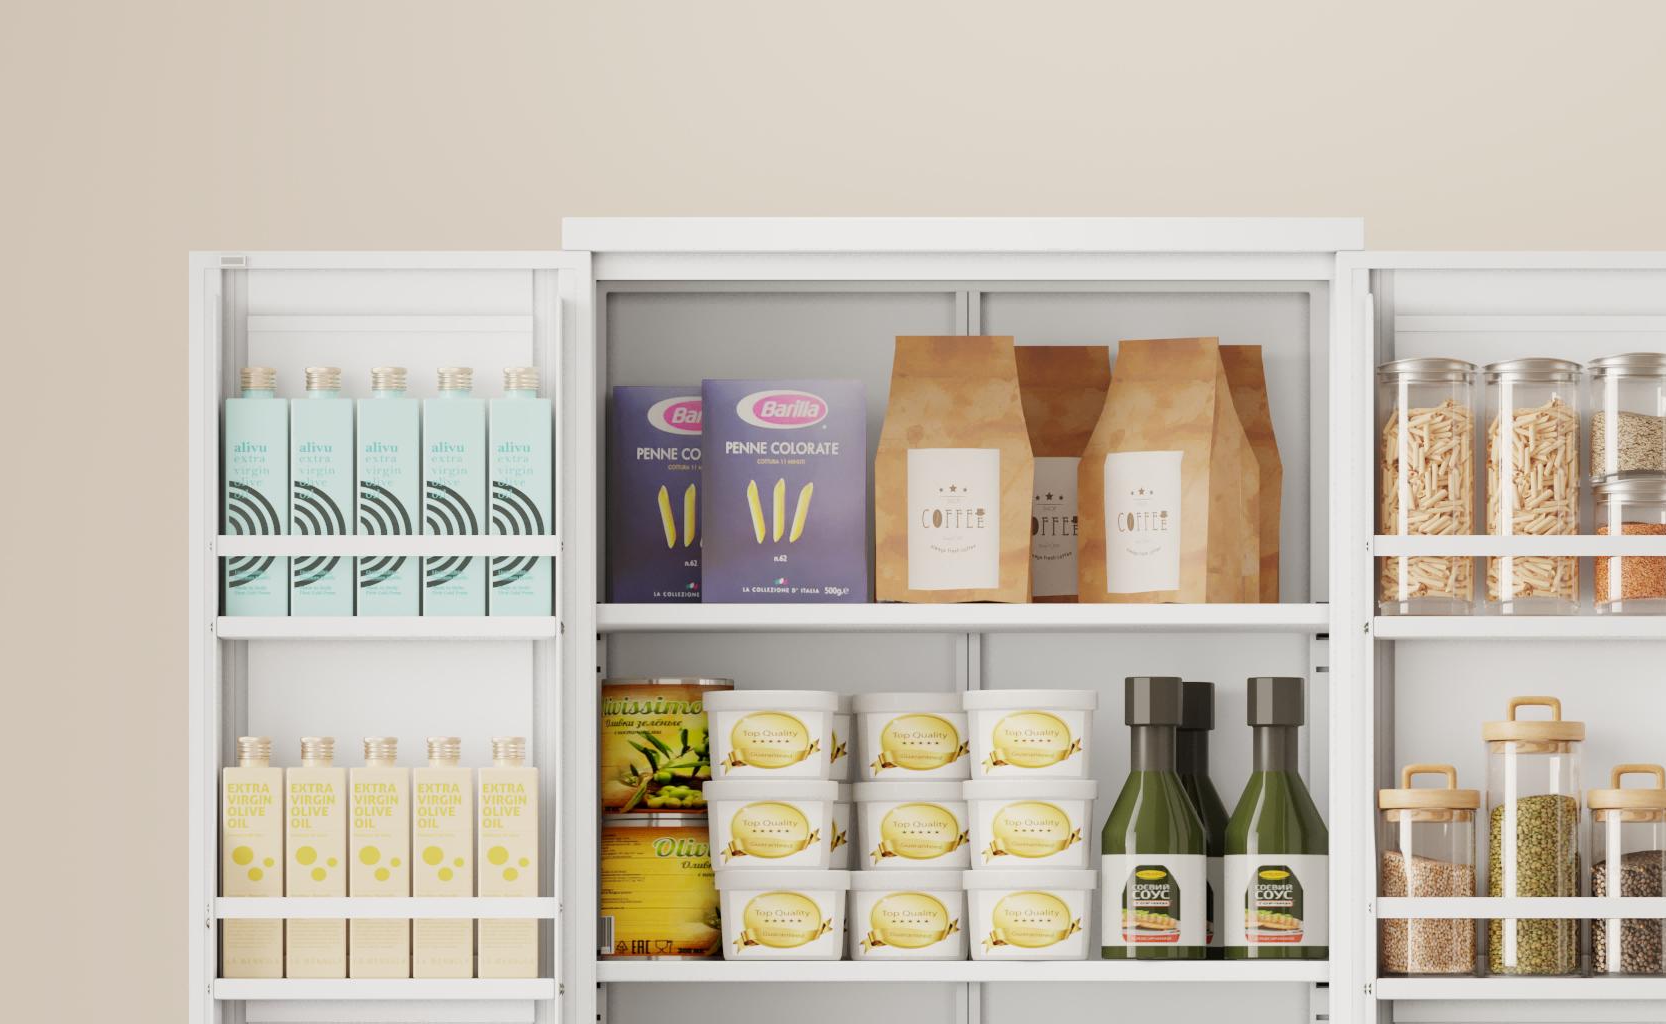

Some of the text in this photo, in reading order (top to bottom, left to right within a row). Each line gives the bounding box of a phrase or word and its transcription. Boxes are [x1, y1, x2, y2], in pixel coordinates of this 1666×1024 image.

[761, 400, 819, 418] Barilla
[234, 442, 267, 452] alivu
[299, 442, 333, 452] alivu
[365, 442, 399, 452] alivu
[431, 442, 465, 452] alivu
[498, 442, 531, 452] alivu
[725, 441, 839, 456] PENNE COLORATE
[637, 447, 677, 460] PENNE
[234, 455, 265, 463] extra
[299, 455, 330, 463] extra
[365, 455, 396, 463] extra
[431, 455, 462, 463] extra
[498, 455, 529, 463] extra
[234, 466, 269, 476] virgin
[299, 466, 335, 476] virgin
[365, 466, 401, 476] virgin
[431, 466, 467, 476] virgin
[498, 466, 533, 476] virgin
[922, 508, 985, 528] COFFEE
[1118, 511, 1167, 532] COFFEE
[1033, 516, 1078, 536] OFFEE
[743, 730, 798, 738] Top Quality
[893, 732, 948, 740] Top Quality
[1005, 730, 1060, 738] Top Quality
[227, 784, 269, 793] EXTRA
[291, 784, 333, 793] EXTRA
[354, 784, 396, 793] EXTRA
[418, 784, 460, 793] EXTRA
[483, 784, 525, 793] EXTRA
[227, 795, 272, 805] VIRGIN
[291, 795, 335, 805] VIRGIN
[354, 795, 399, 805] VIRGIN
[418, 795, 462, 805] VIRGIN
[483, 795, 527, 805] VIRGIN
[227, 806, 265, 816] OLIVE
[291, 806, 328, 816] OLIVE
[354, 806, 392, 816] OLIVE
[418, 806, 455, 816] OLIVE
[483, 806, 520, 816] OLIVE
[227, 818, 248, 828] OIL
[291, 818, 311, 828] OIL
[354, 818, 375, 828] OIL
[418, 818, 438, 828] OIL
[483, 818, 503, 828] OIL
[743, 820, 798, 828] Top Quality
[893, 821, 948, 829] Top Quality
[1133, 890, 1170, 900] СОУС
[1255, 890, 1293, 899] СОУС
[755, 910, 810, 918] Top Quality
[883, 910, 938, 918] Top Quality
[1005, 910, 1060, 918] Top Quality
[632, 940, 650, 954] EAC
